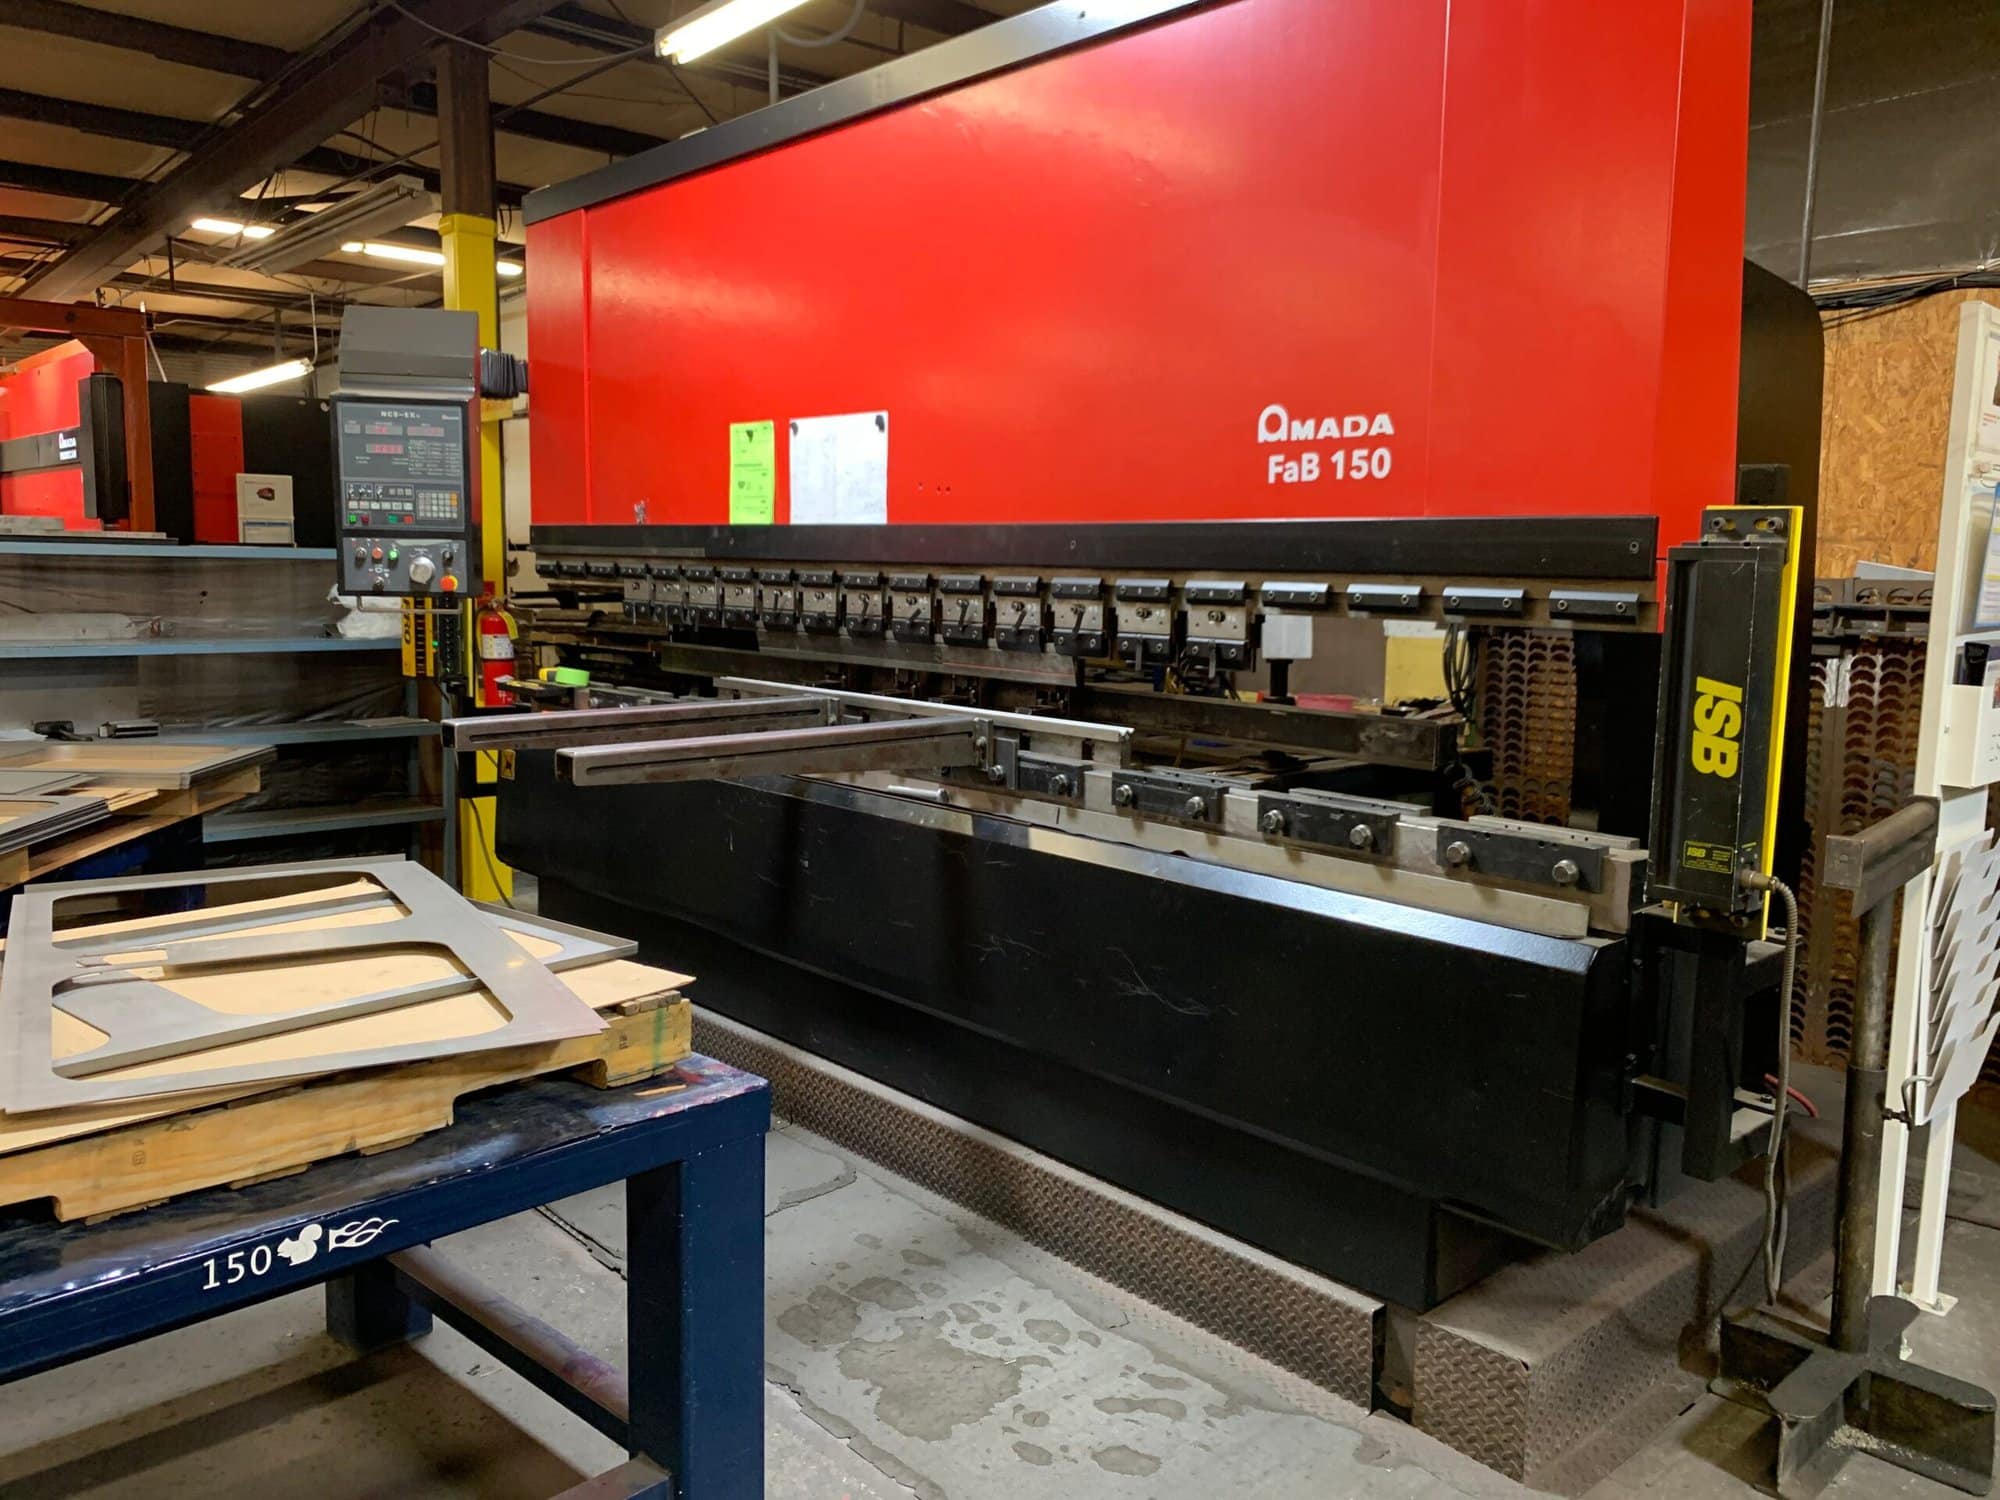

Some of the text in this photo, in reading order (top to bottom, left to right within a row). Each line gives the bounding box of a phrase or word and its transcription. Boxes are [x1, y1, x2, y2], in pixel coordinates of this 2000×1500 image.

[1257, 404, 1394, 442] AMADA
[1268, 447, 1392, 484] FaB 150
[1692, 676, 1743, 779] ISB
[202, 1245, 272, 1290] 150
